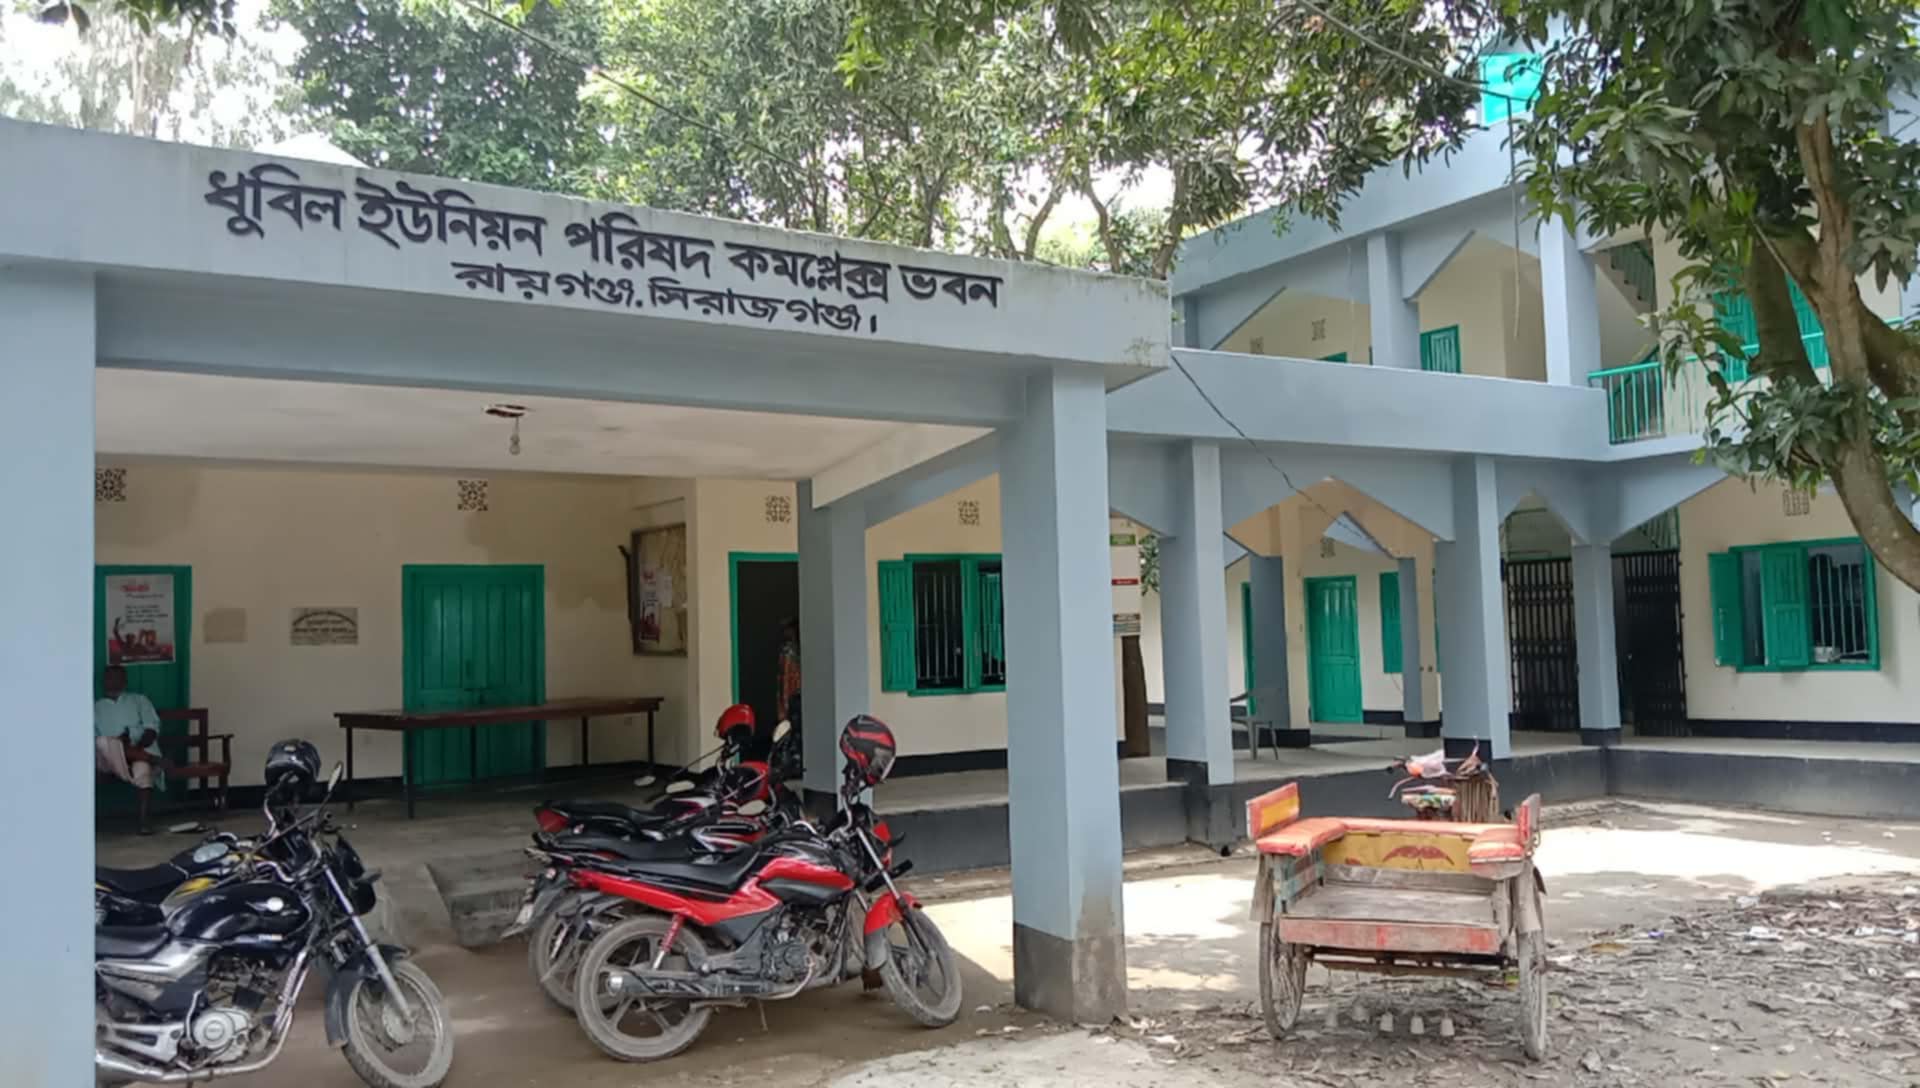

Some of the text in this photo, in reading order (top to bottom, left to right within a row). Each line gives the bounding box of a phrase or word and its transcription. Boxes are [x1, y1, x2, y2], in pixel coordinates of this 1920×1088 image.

[204, 162, 1004, 308] ধুবিল ইউনিয়ন পরিষদ কমপ্লেক্স ভবন
